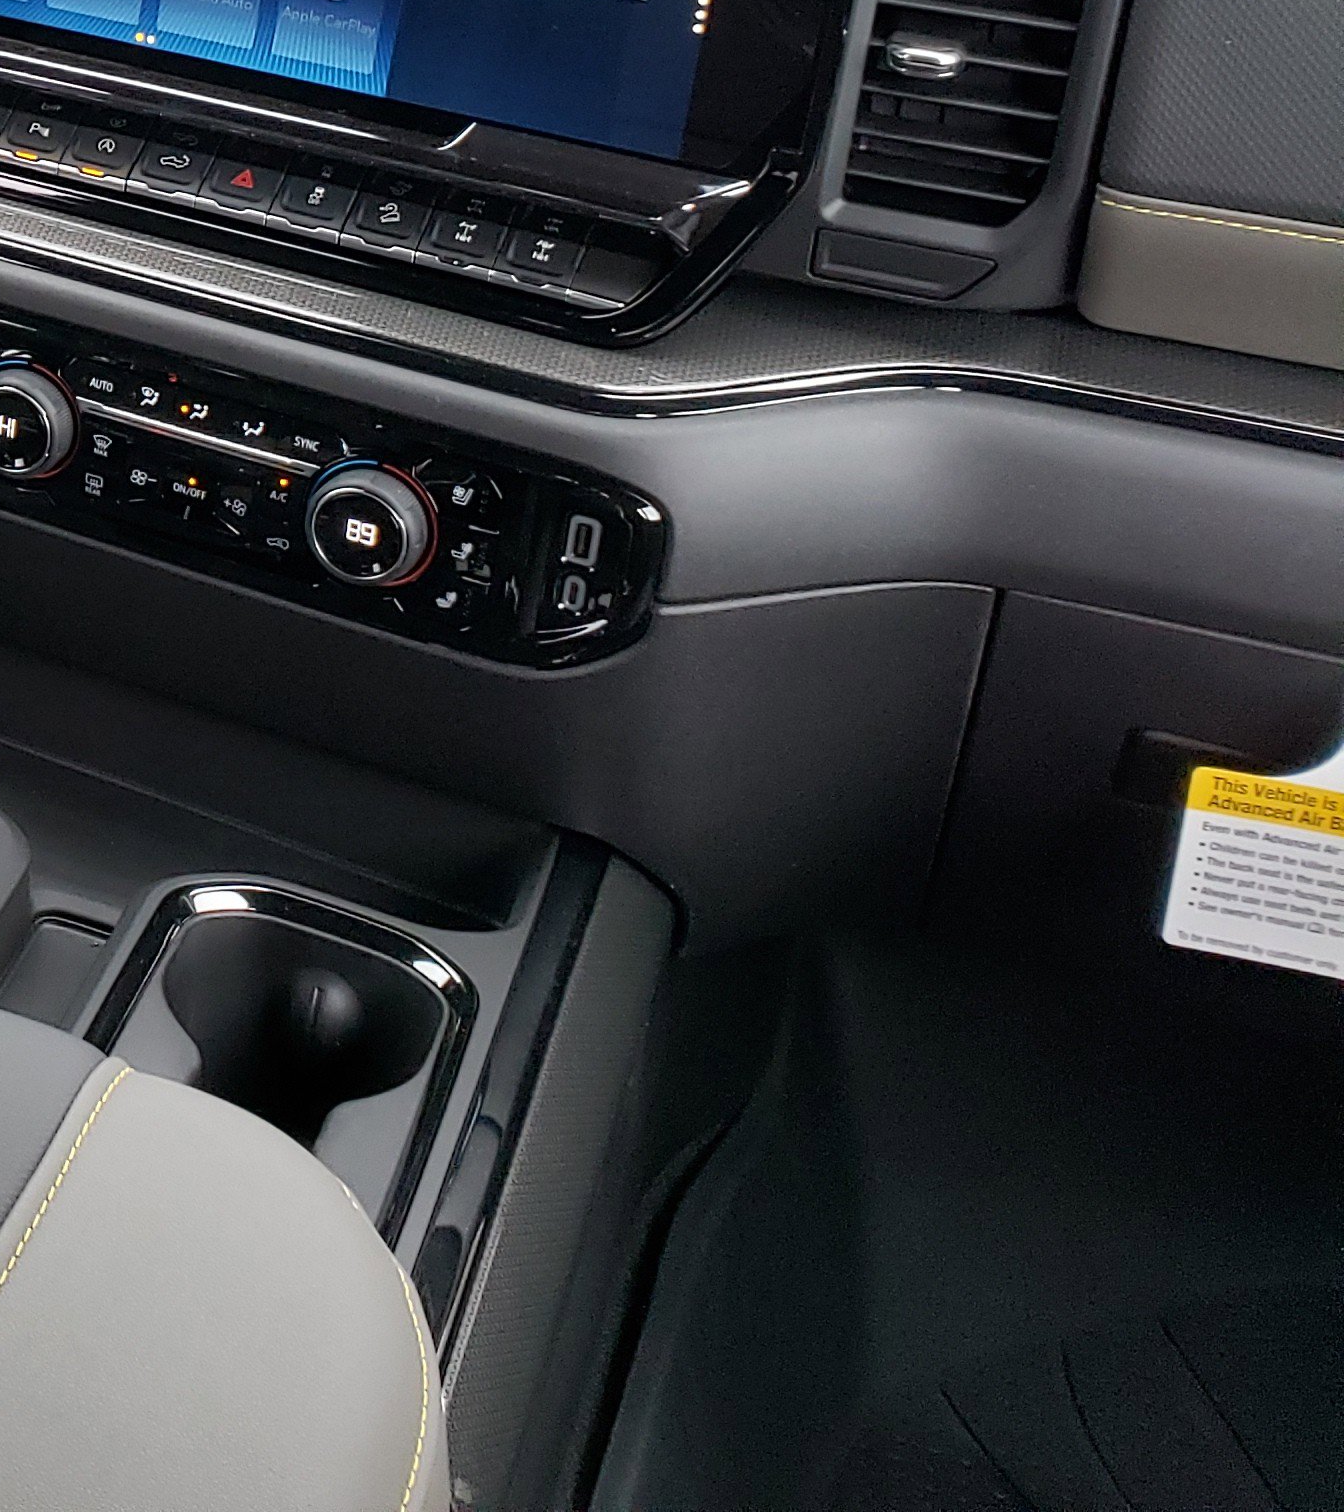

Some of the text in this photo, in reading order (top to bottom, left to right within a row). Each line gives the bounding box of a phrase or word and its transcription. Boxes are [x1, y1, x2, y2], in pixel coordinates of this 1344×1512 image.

[281, 5, 377, 38] Apple CarPlay
[89, 377, 113, 393] AUTO
[293, 435, 320, 452] SYNC
[172, 482, 207, 501] ON/OFF
[269, 490, 288, 504] A/C
[346, 518, 379, 547] 89
[1213, 775, 1338, 811] This Vehicle is
[1208, 794, 1294, 822] Advanced
[1297, 810, 1325, 827] Air
[1202, 821, 1231, 834] Even
[1233, 827, 1259, 839] with
[1262, 833, 1321, 852] Advanced
